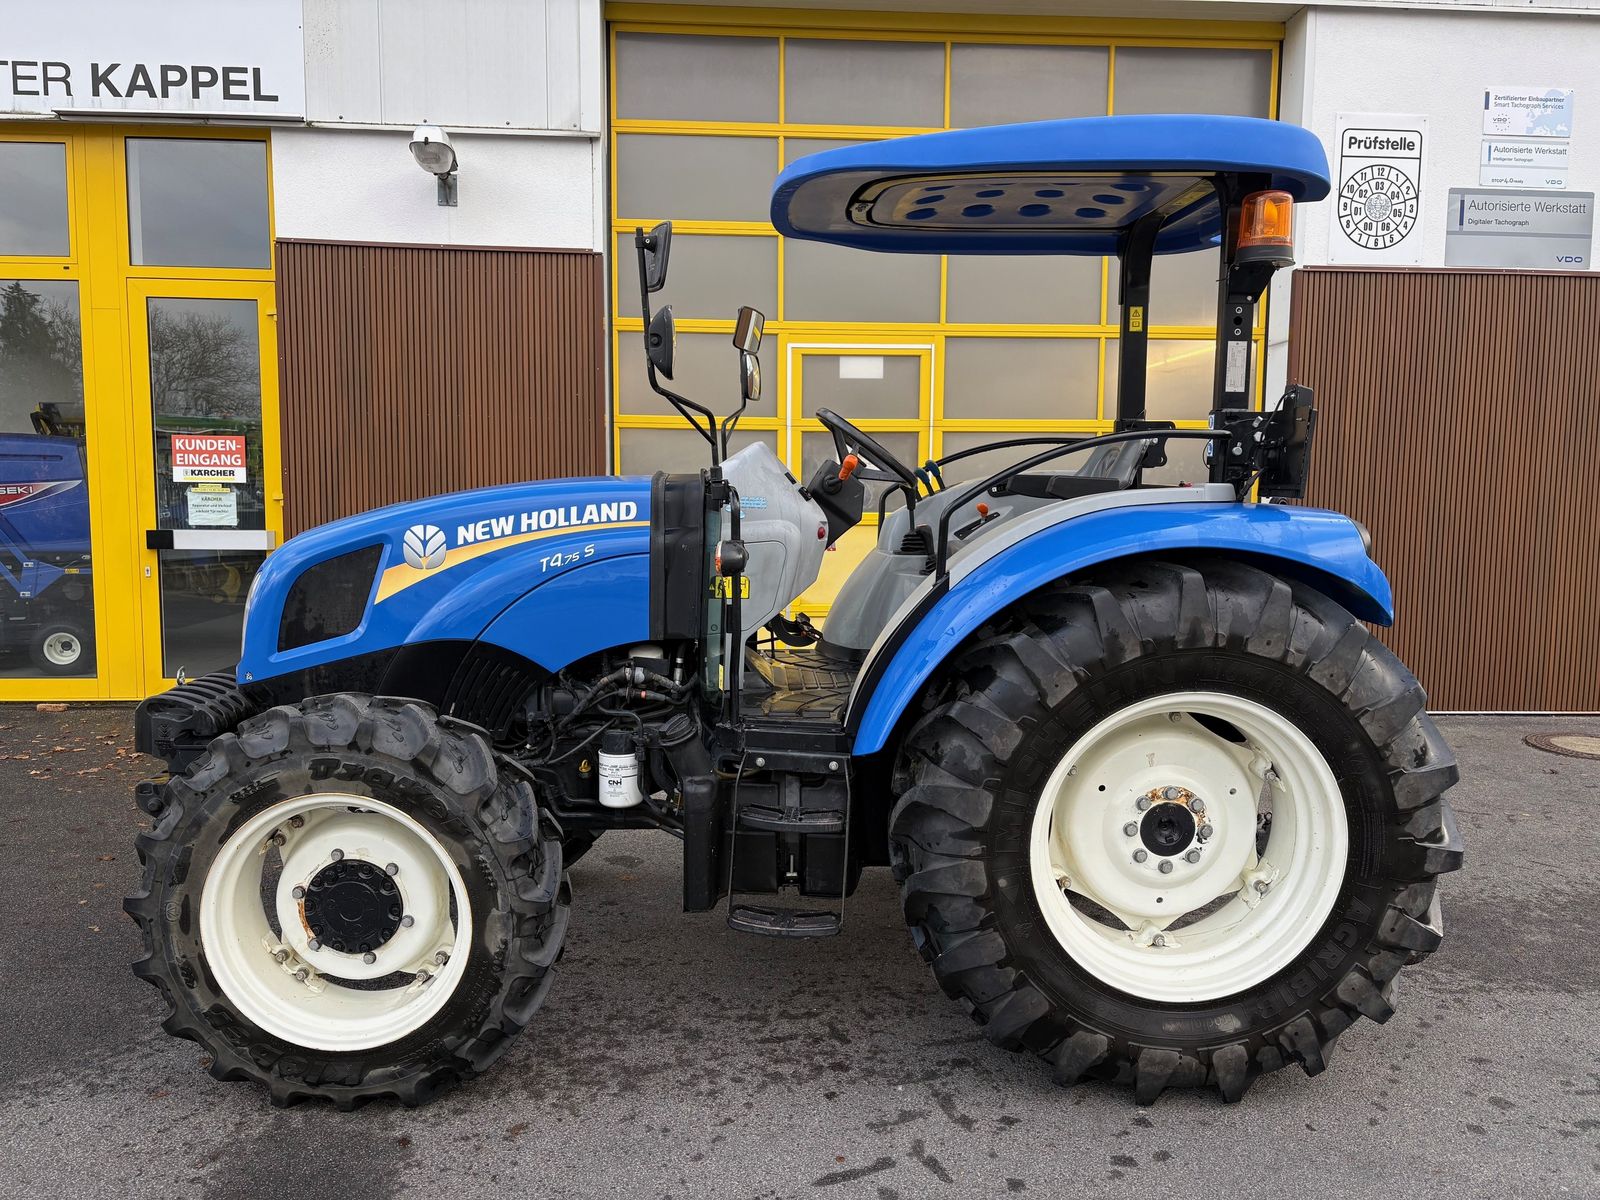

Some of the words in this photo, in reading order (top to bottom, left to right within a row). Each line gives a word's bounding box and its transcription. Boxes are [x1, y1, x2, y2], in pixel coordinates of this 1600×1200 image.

[90, 62, 279, 102] KAPPEL
[1494, 94, 1528, 102] Zertifizierter
[1528, 95, 1565, 103] Einbaupartner
[1348, 136, 1416, 151] Prüfstelle
[1493, 145, 1533, 154] Autorisierte
[1534, 147, 1567, 155] Werkstatt
[1360, 172, 1367, 181] 11
[1378, 168, 1385, 176] 12
[1347, 184, 1354, 194] 10
[1375, 182, 1384, 190] 03
[1358, 190, 1368, 198] 02
[1391, 191, 1400, 200] 04
[1354, 206, 1362, 216] 01
[1468, 200, 1531, 212] Autorisierte
[1534, 201, 1586, 214] Werkstatt
[1393, 208, 1402, 218] 05
[1364, 222, 1372, 231] 00
[1381, 222, 1390, 231] 06
[175, 439, 242, 451] KUNDEN-
[176, 454, 242, 466] EINGANG
[457, 514, 514, 546] NEW
[520, 501, 637, 532] HOLLAND
[539, 552, 580, 572] T4.75
[584, 544, 595, 558] S
[1256, 895, 1375, 1019] AGRIBIB
